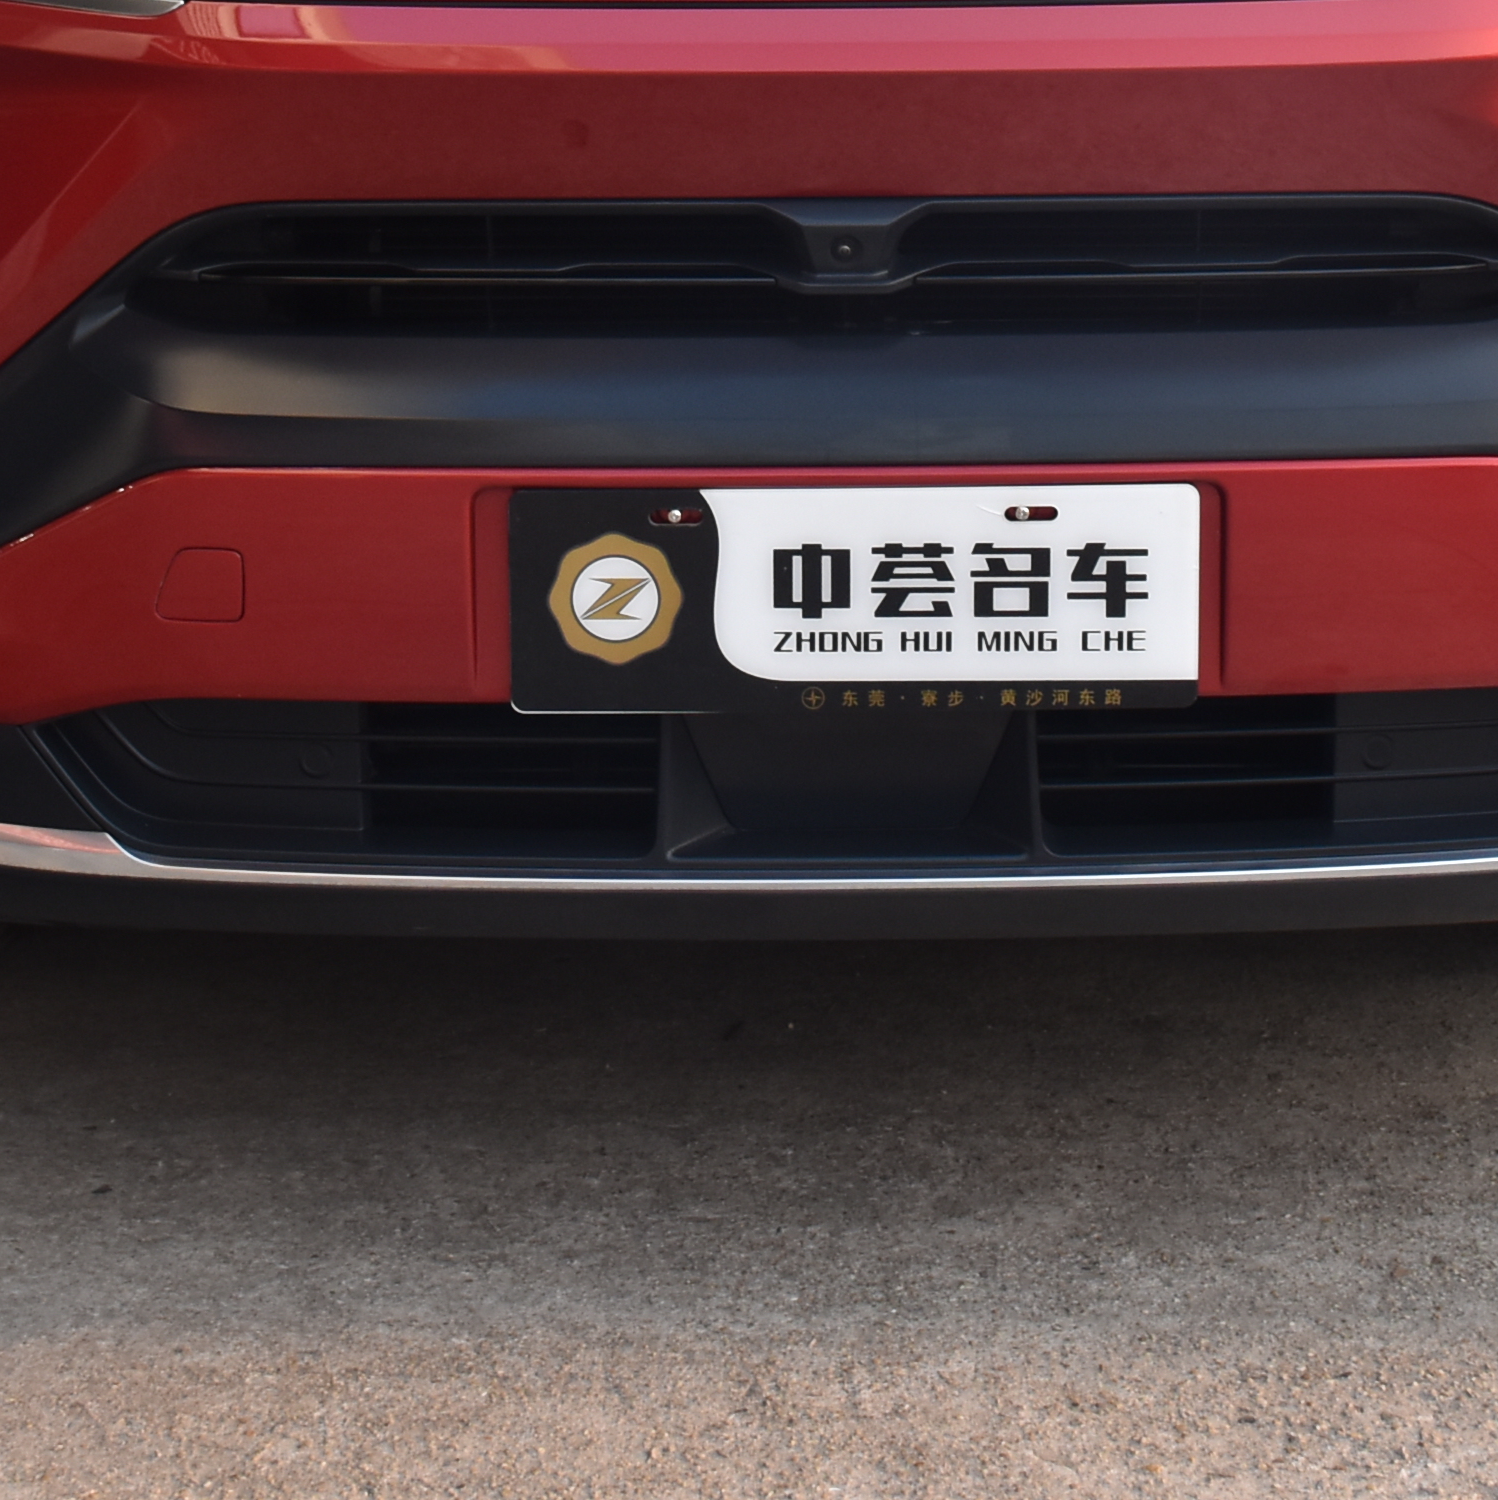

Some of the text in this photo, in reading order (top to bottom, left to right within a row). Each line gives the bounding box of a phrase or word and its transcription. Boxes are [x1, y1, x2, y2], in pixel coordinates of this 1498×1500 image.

[772, 542, 1150, 619] 中荟名车
[773, 630, 1147, 654] ZHONG HUI MING CHE
